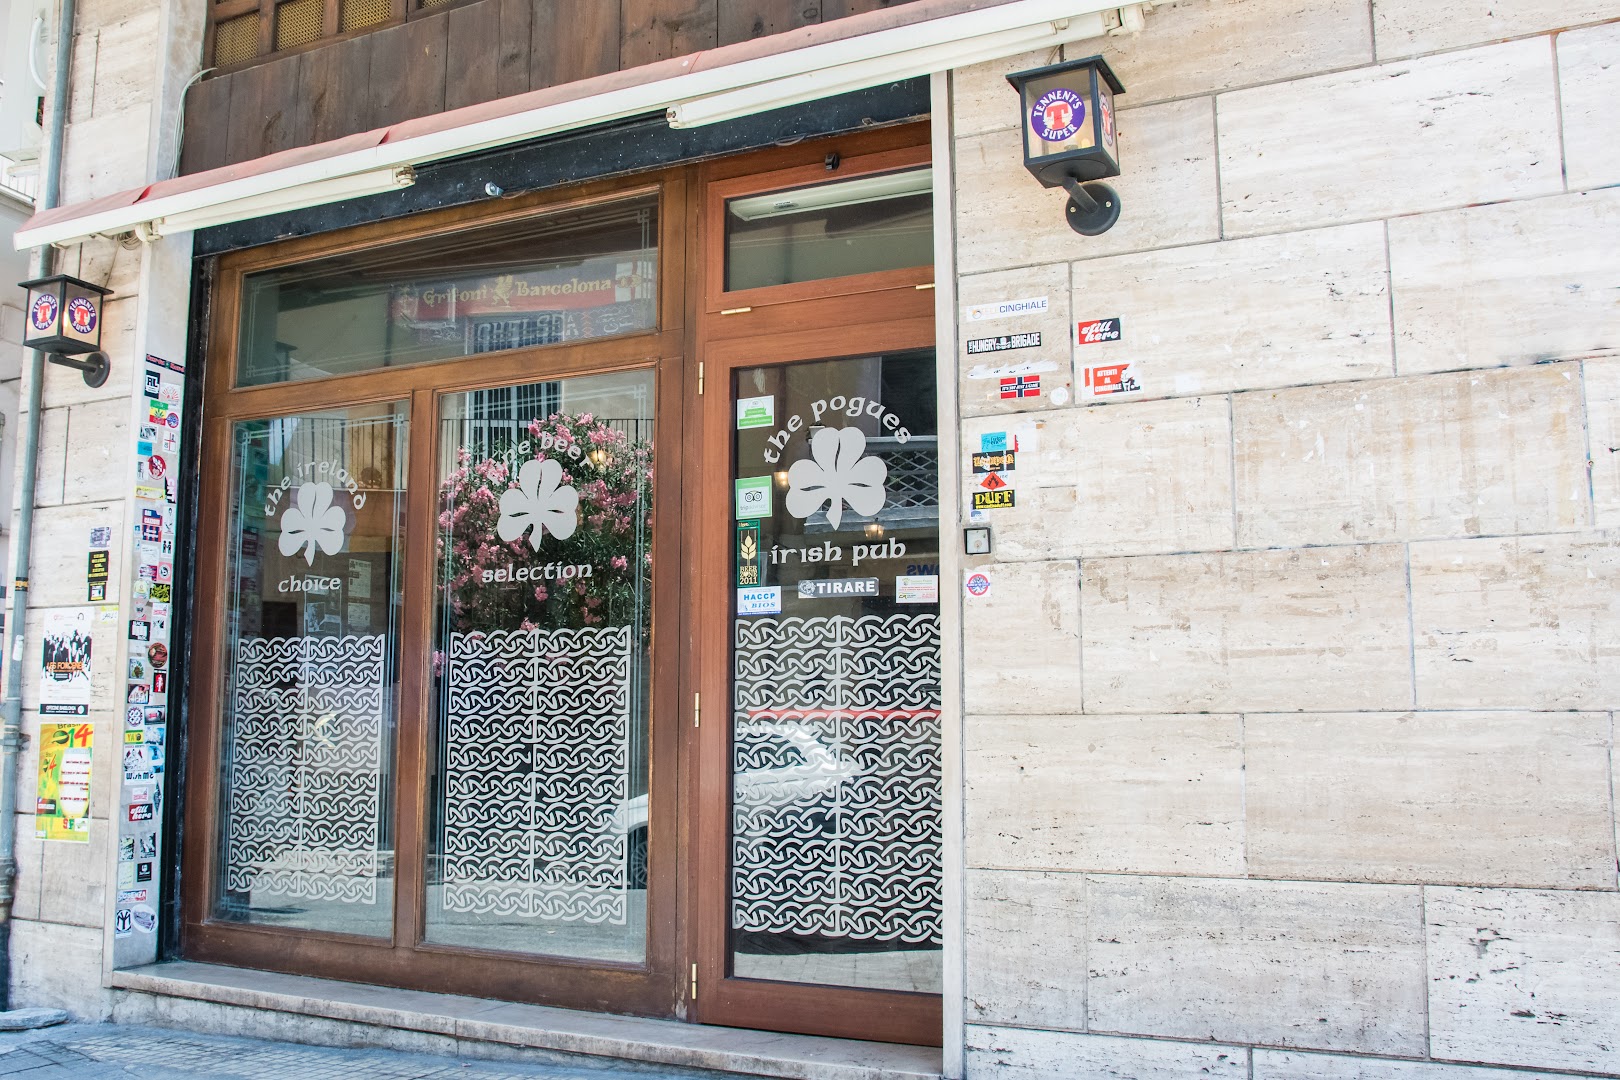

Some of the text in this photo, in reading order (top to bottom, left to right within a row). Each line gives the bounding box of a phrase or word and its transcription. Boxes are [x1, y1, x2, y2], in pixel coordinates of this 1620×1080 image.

[1033, 90, 1082, 117] TENNENT'S
[1046, 102, 1069, 131] T
[1042, 123, 1077, 139] SUPER
[515, 277, 611, 297] Barcelona
[33, 294, 57, 313] TENNENT'S
[39, 304, 50, 323] T
[69, 298, 96, 318] TENNENT'S
[35, 319, 52, 329] SUPER
[72, 321, 91, 333] SUPER
[77, 307, 89, 327] T
[972, 337, 997, 353] HUNGRY
[1011, 333, 1041, 349] BRIGADE
[763, 395, 912, 464] the pogues
[541, 431, 595, 470] beer
[264, 459, 367, 517] the ireland
[975, 490, 1013, 505] DUFF
[769, 537, 907, 567] irish pub
[481, 561, 593, 584] selection
[278, 575, 341, 593] choice
[816, 580, 876, 594] TIRARE
[743, 592, 776, 601] HACCP
